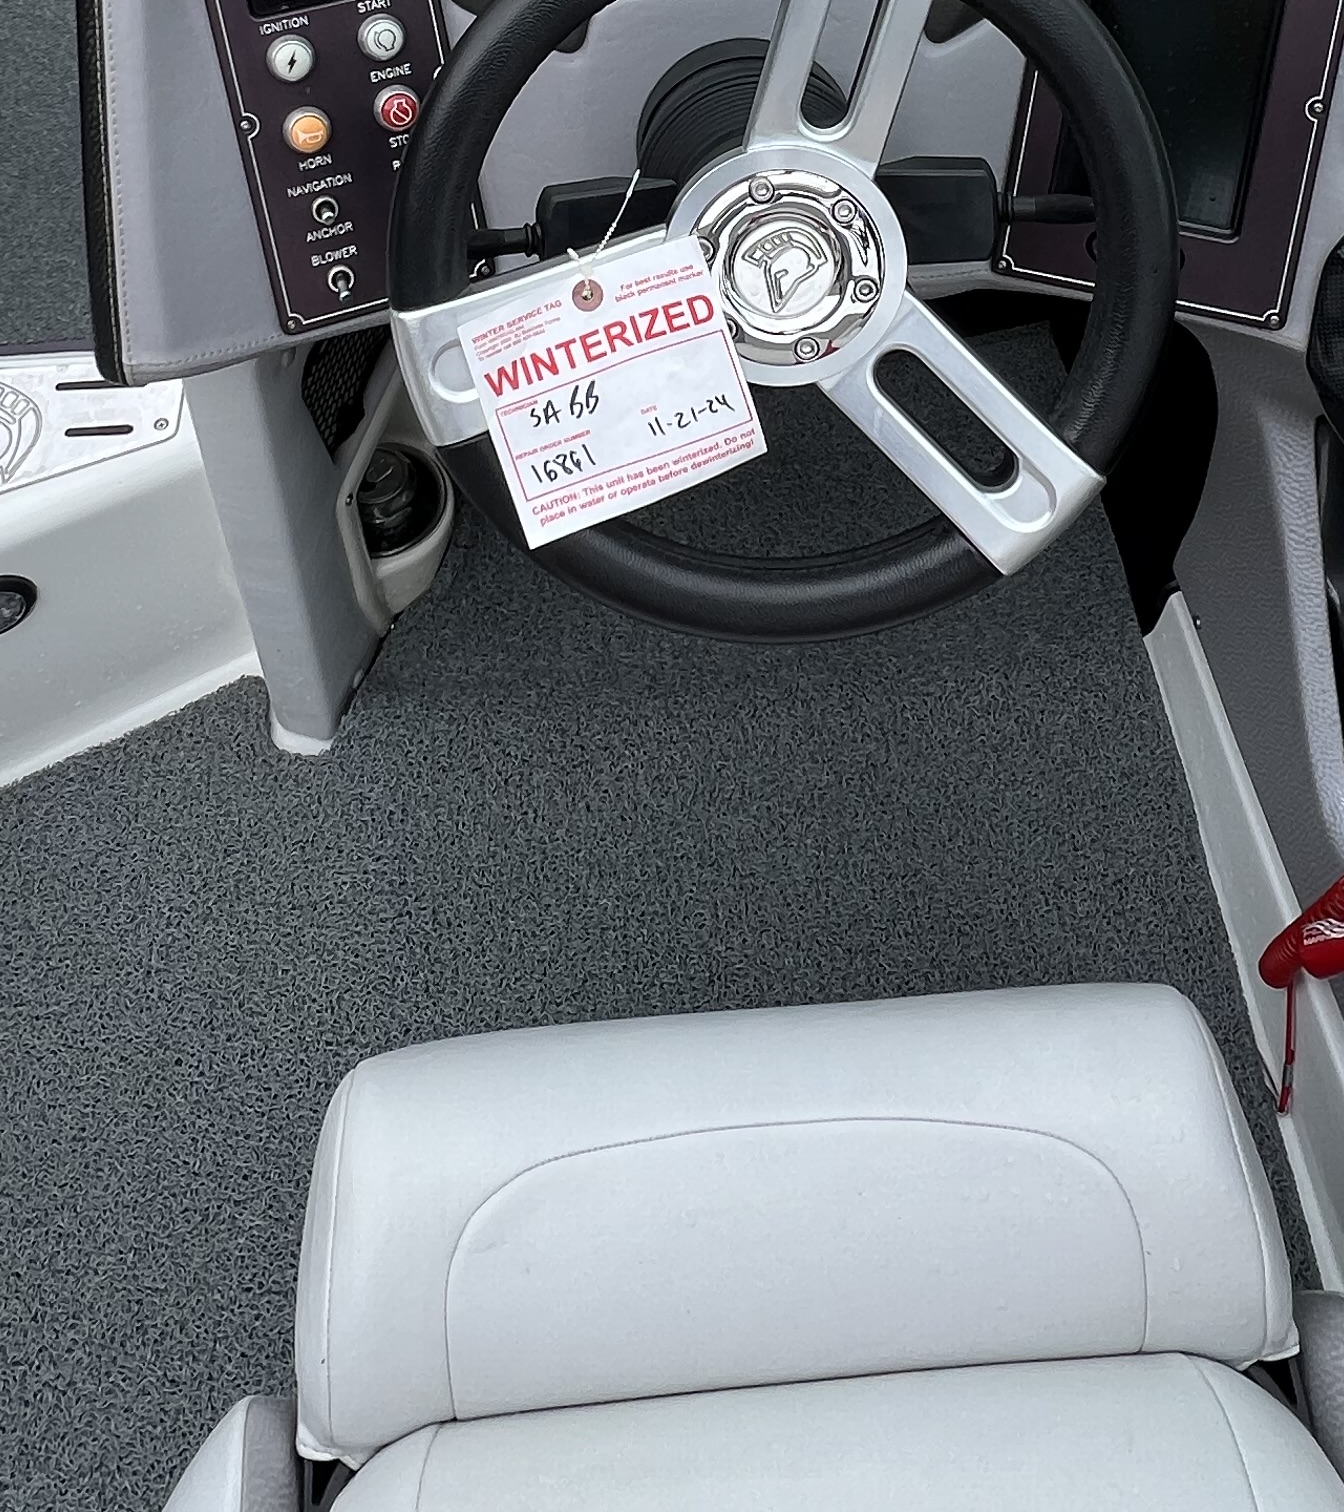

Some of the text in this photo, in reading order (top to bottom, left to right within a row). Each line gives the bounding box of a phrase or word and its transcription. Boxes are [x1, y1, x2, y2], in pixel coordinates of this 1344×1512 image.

[259, 16, 310, 35] IGNITION
[370, 63, 412, 83] ENGINE
[388, 134, 410, 148] STO
[298, 153, 333, 171] HORN
[287, 173, 353, 197] NAVIGATION
[306, 221, 354, 242] ANCHOR
[311, 245, 358, 267] BLOWER
[544, 299, 562, 311] TAG
[484, 294, 714, 397] WINTERIZED
[648, 394, 735, 436] 11-21-24
[582, 484, 604, 496] This
[606, 476, 625, 488] unit
[627, 471, 645, 482] has
[646, 461, 670, 475] been
[724, 436, 737, 446] Do
[740, 428, 755, 439] not
[540, 511, 565, 527] place
[568, 504, 577, 514] in
[579, 496, 605, 509] water
[608, 490, 618, 499] or
[620, 479, 656, 496] operate
[658, 467, 688, 483] before
